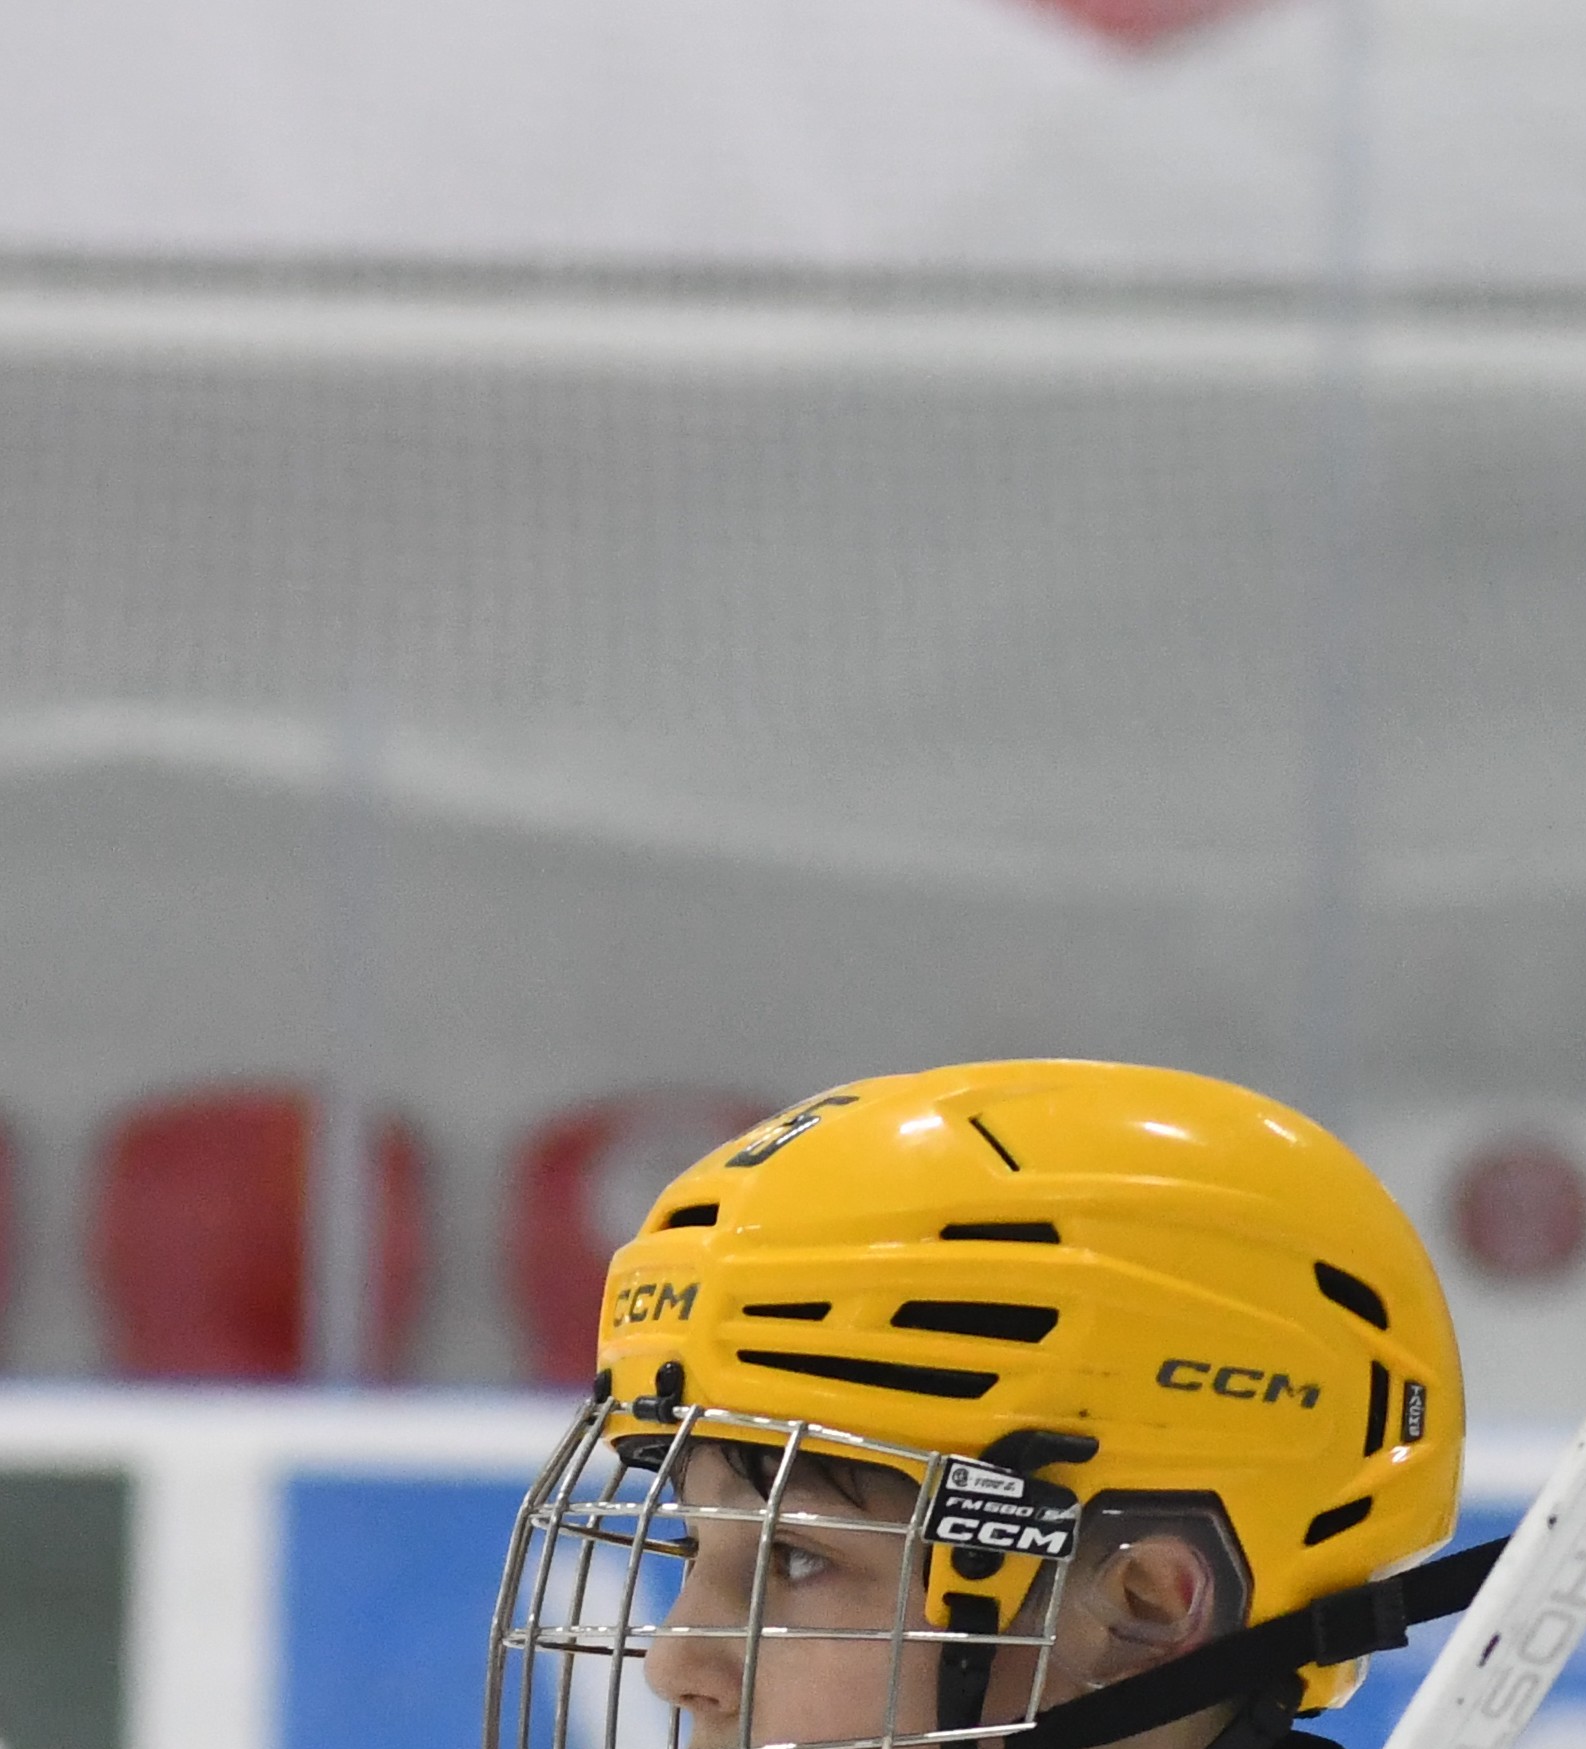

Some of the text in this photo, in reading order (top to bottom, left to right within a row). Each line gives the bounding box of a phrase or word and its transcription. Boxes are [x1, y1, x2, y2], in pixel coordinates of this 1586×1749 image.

[613, 1283, 700, 1328] CCM
[1156, 1358, 1322, 1410] CCM
[935, 1516, 1069, 1555] CCM
